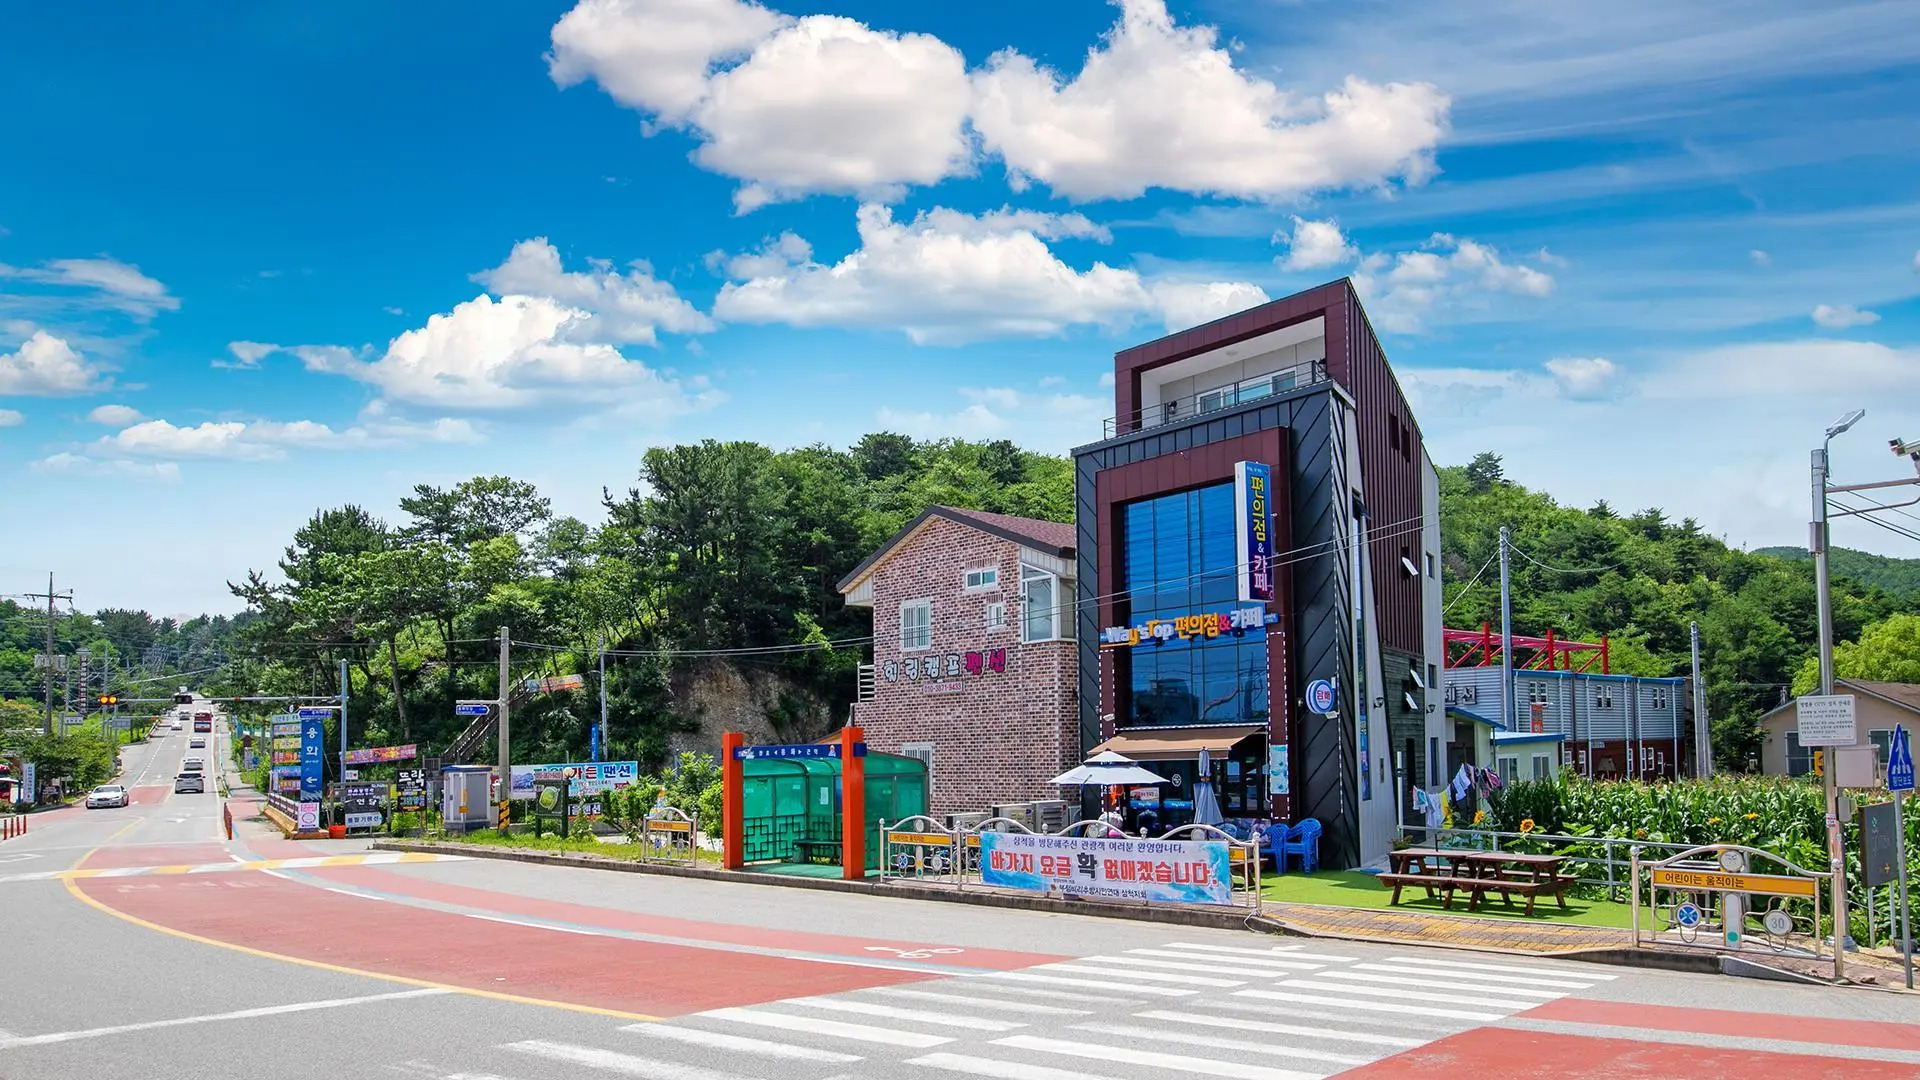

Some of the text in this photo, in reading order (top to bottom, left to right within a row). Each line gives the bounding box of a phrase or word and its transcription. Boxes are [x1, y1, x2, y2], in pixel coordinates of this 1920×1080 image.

[1251, 476, 1268, 591] 편의점&카페
[1014, 836, 1186, 854] 삼척을 방문해주신 관광객 여러분 환영합니다.
[991, 850, 1218, 886] 바가지 요금 확 없애겠습니다.
[1665, 873, 1744, 888] 어린이는 움직이는
[1771, 917, 1784, 929] 30
